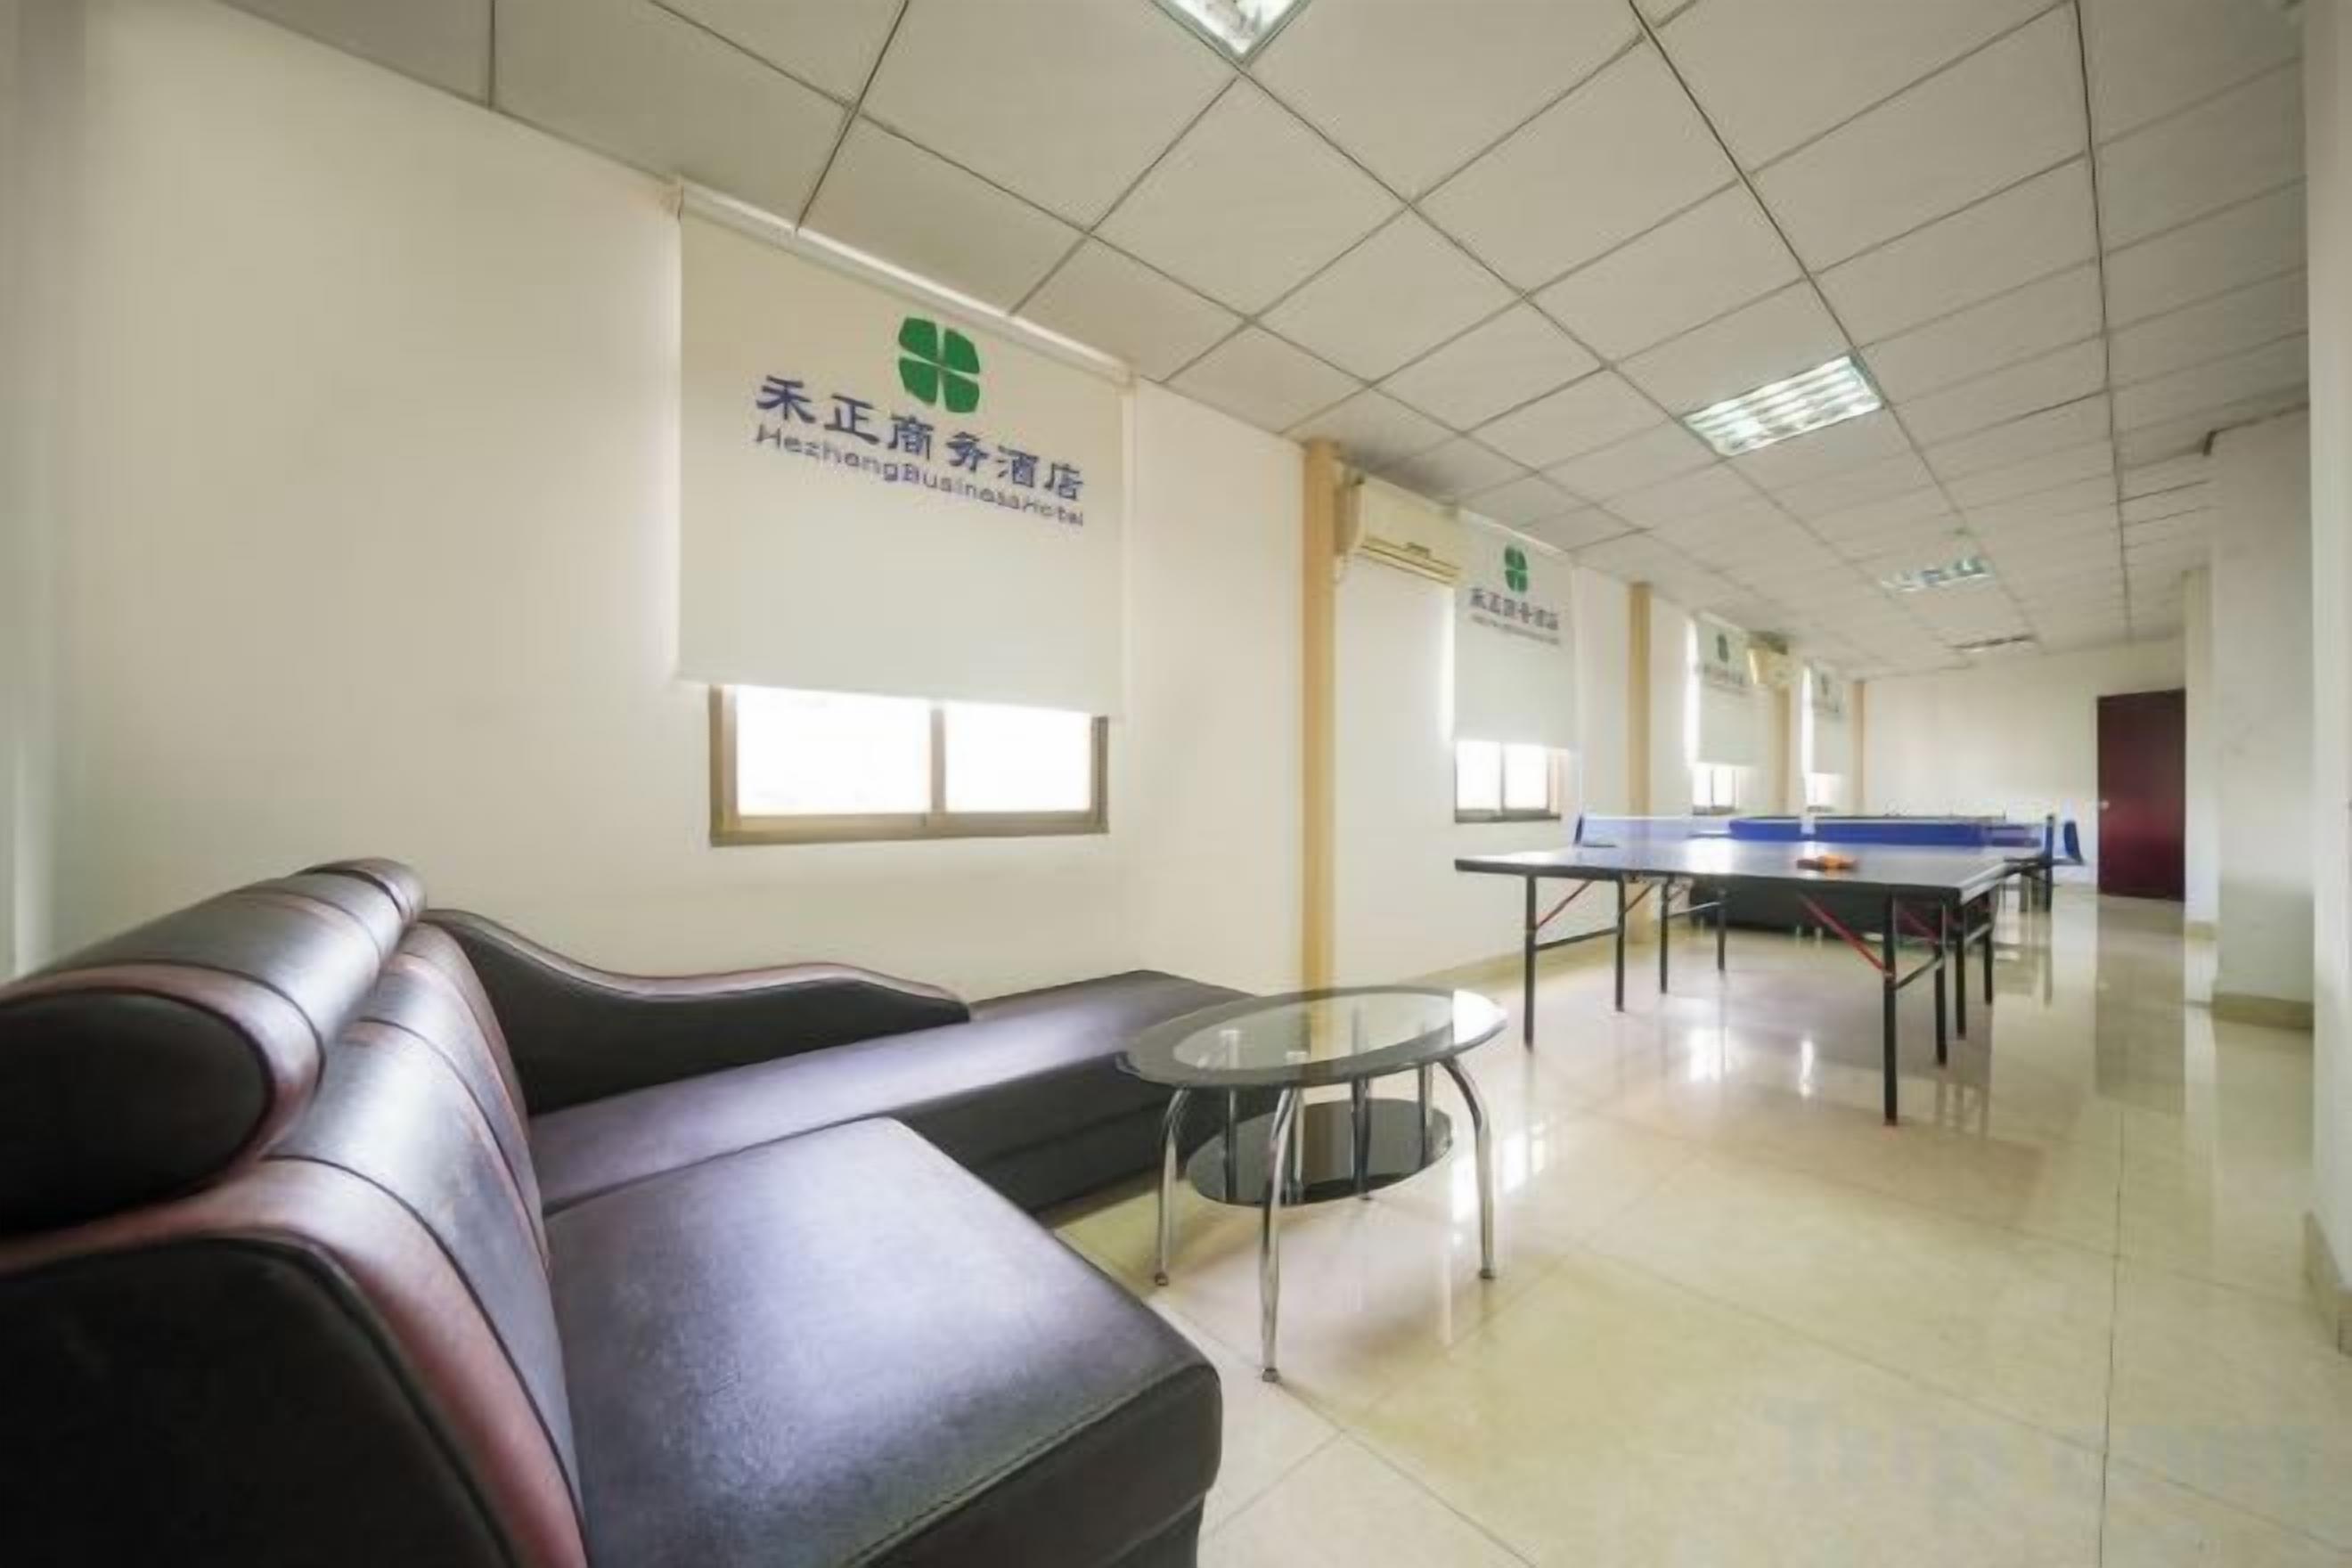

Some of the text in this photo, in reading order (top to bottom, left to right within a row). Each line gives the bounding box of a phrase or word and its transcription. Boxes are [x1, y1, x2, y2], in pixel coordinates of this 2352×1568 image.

[755, 374, 1085, 501] 禾正商务酒店
